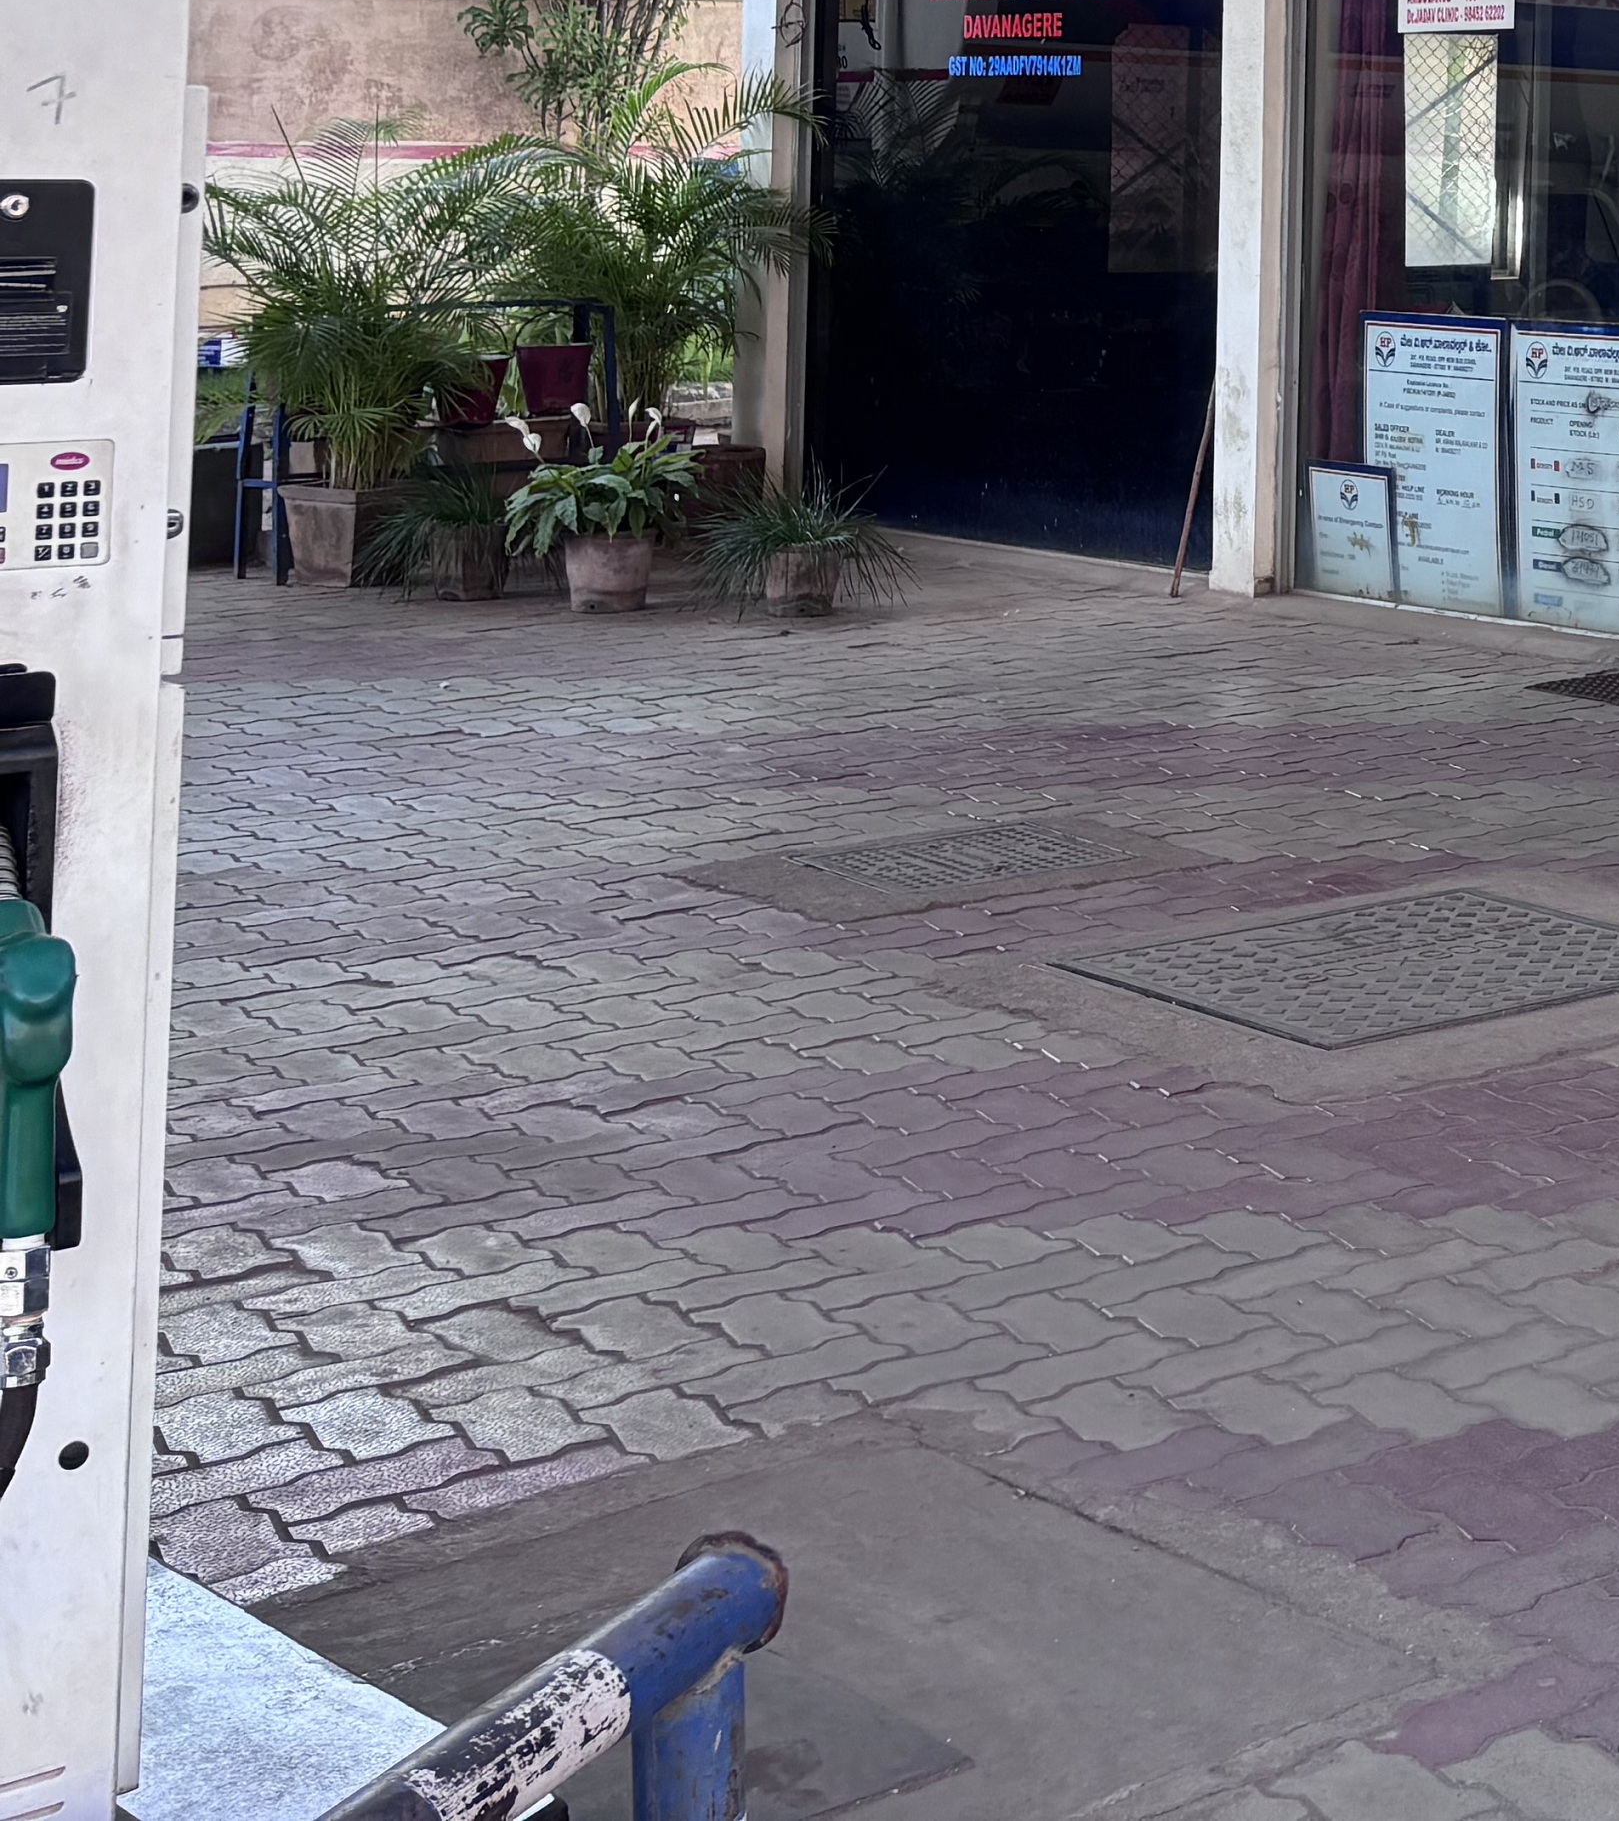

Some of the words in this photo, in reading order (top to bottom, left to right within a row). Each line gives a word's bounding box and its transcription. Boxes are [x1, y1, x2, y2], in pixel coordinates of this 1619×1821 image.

[1437, 7, 1459, 23] CLINIC
[964, 13, 1063, 40] DAVANAGERE
[949, 56, 968, 76] GST
[969, 56, 987, 76] NO:
[26, 73, 77, 126] 7
[1380, 337, 1392, 348] HP
[1531, 348, 1544, 359] HP
